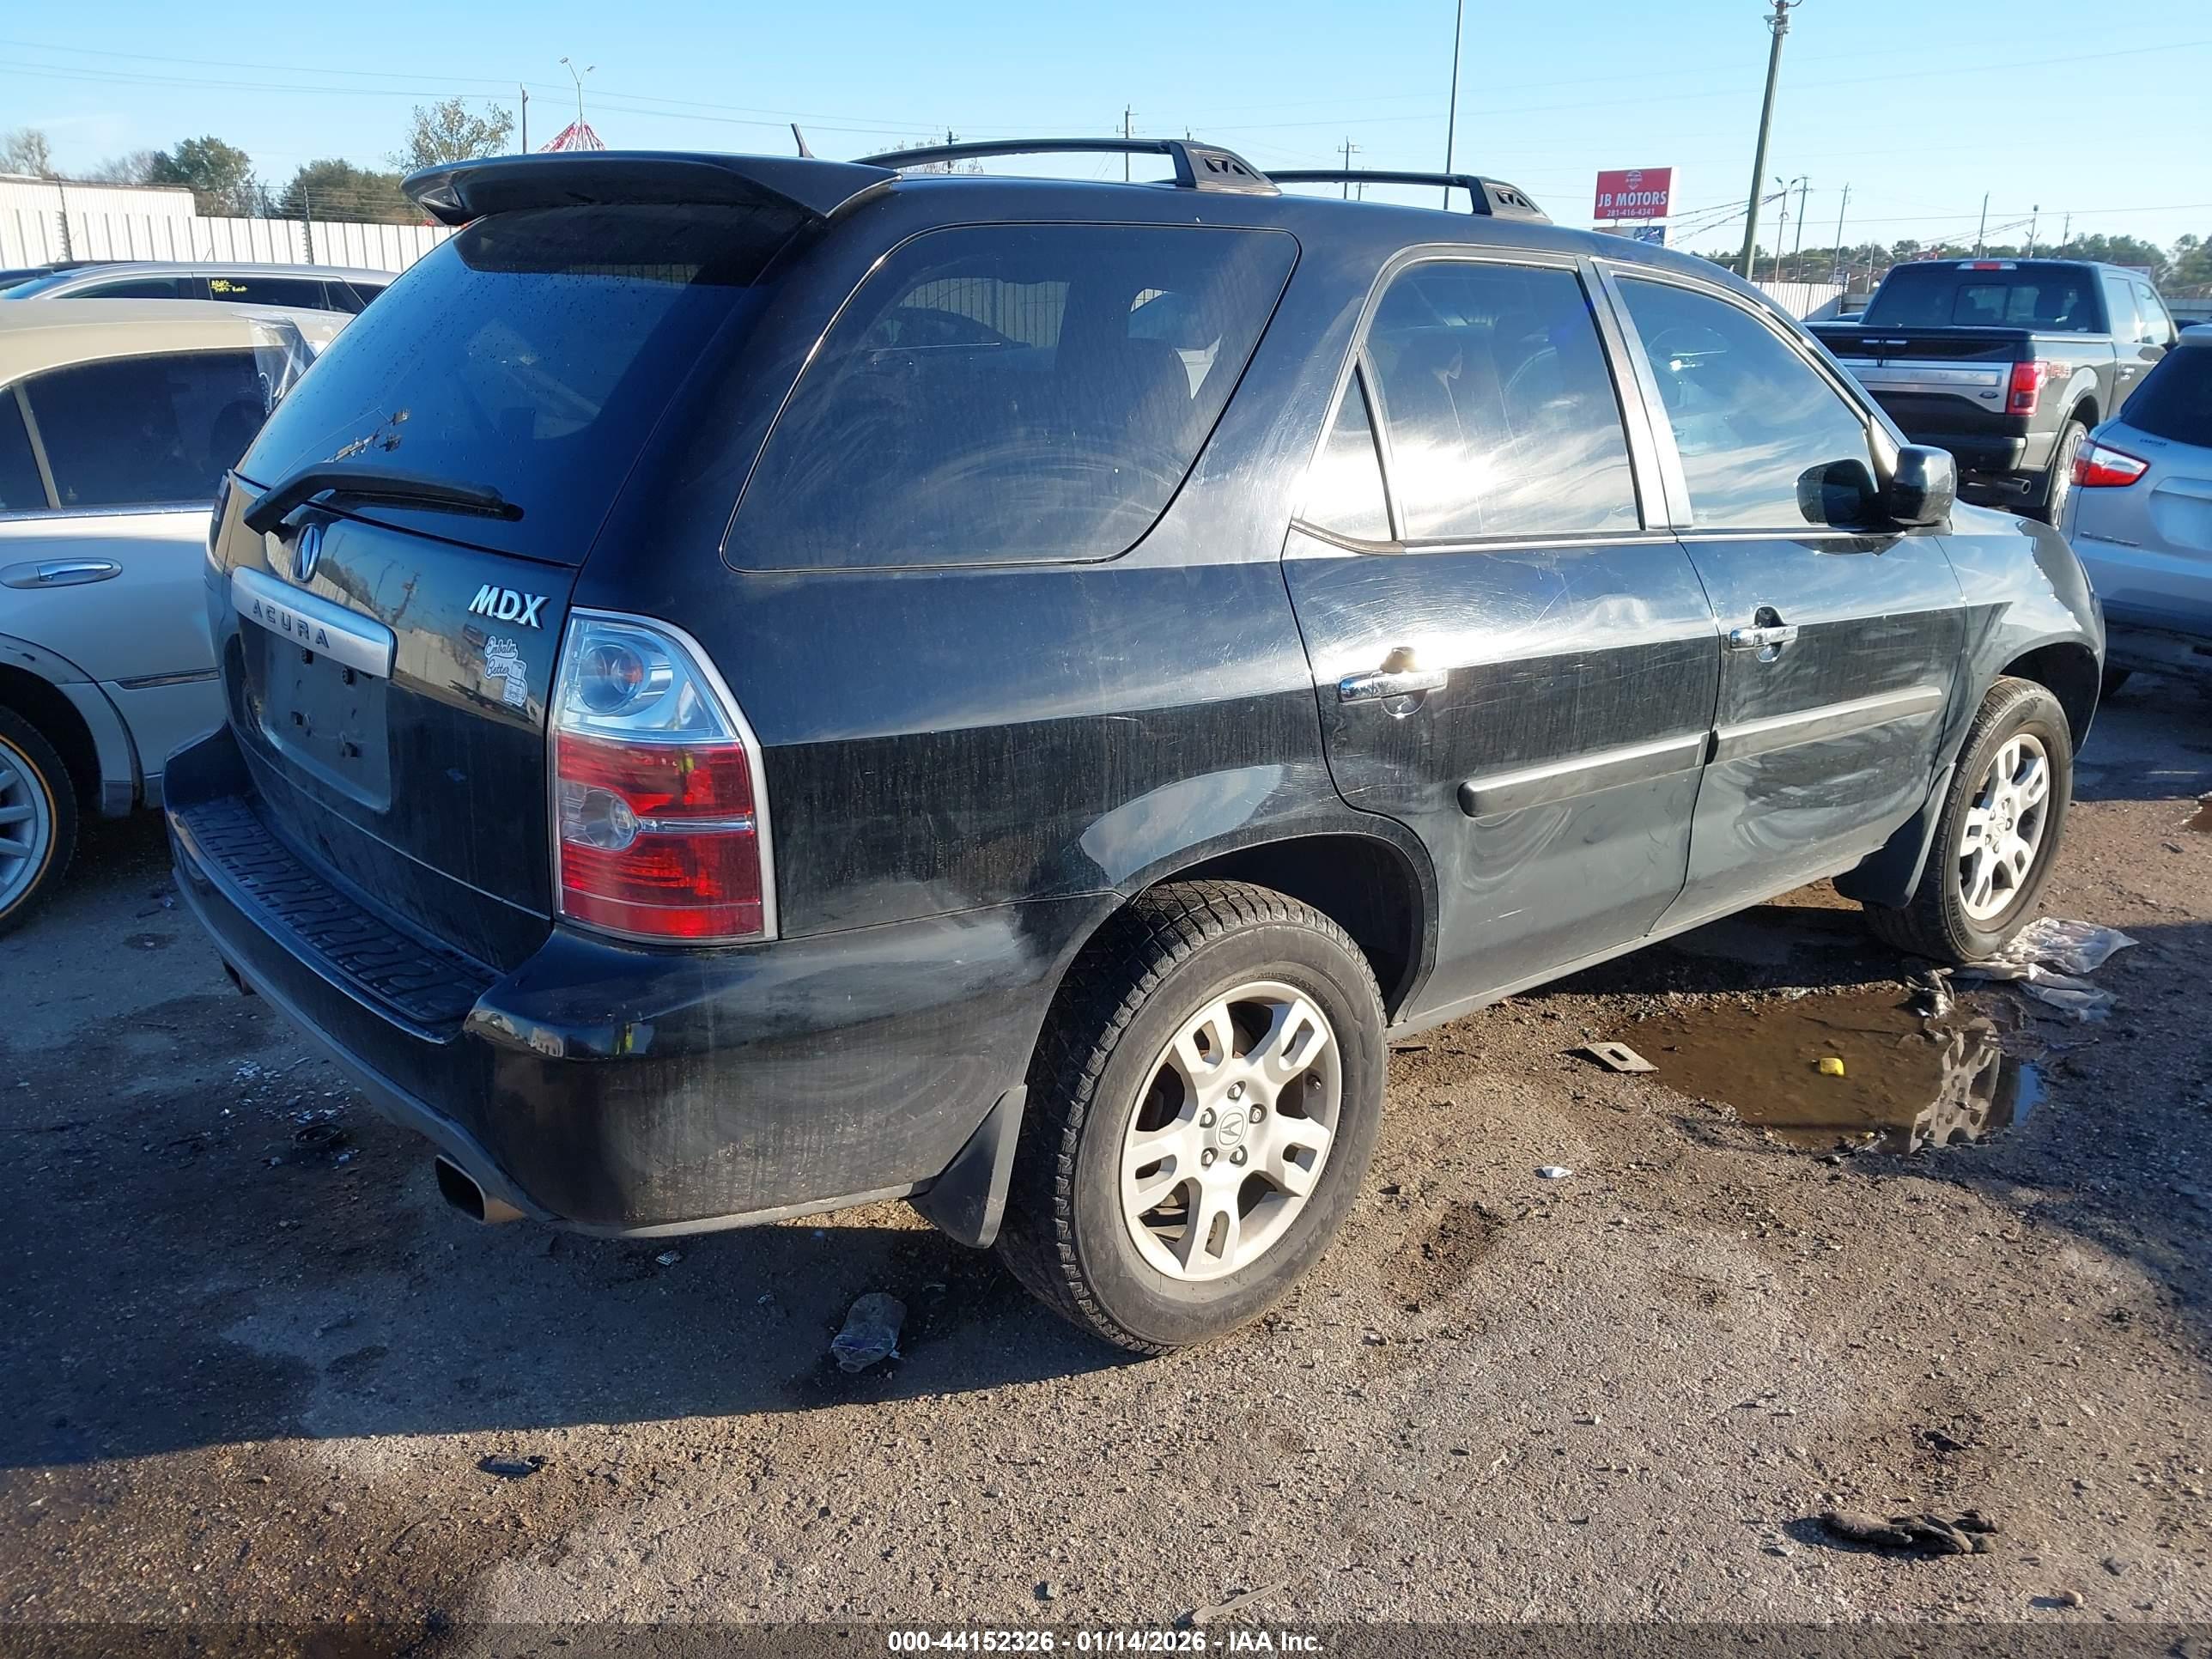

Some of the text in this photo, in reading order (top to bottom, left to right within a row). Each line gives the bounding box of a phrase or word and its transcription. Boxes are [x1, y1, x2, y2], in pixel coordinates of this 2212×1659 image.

[1598, 191, 1667, 207] JB MOTORS
[252, 599, 330, 648] ACURA
[468, 584, 550, 629] MDX
